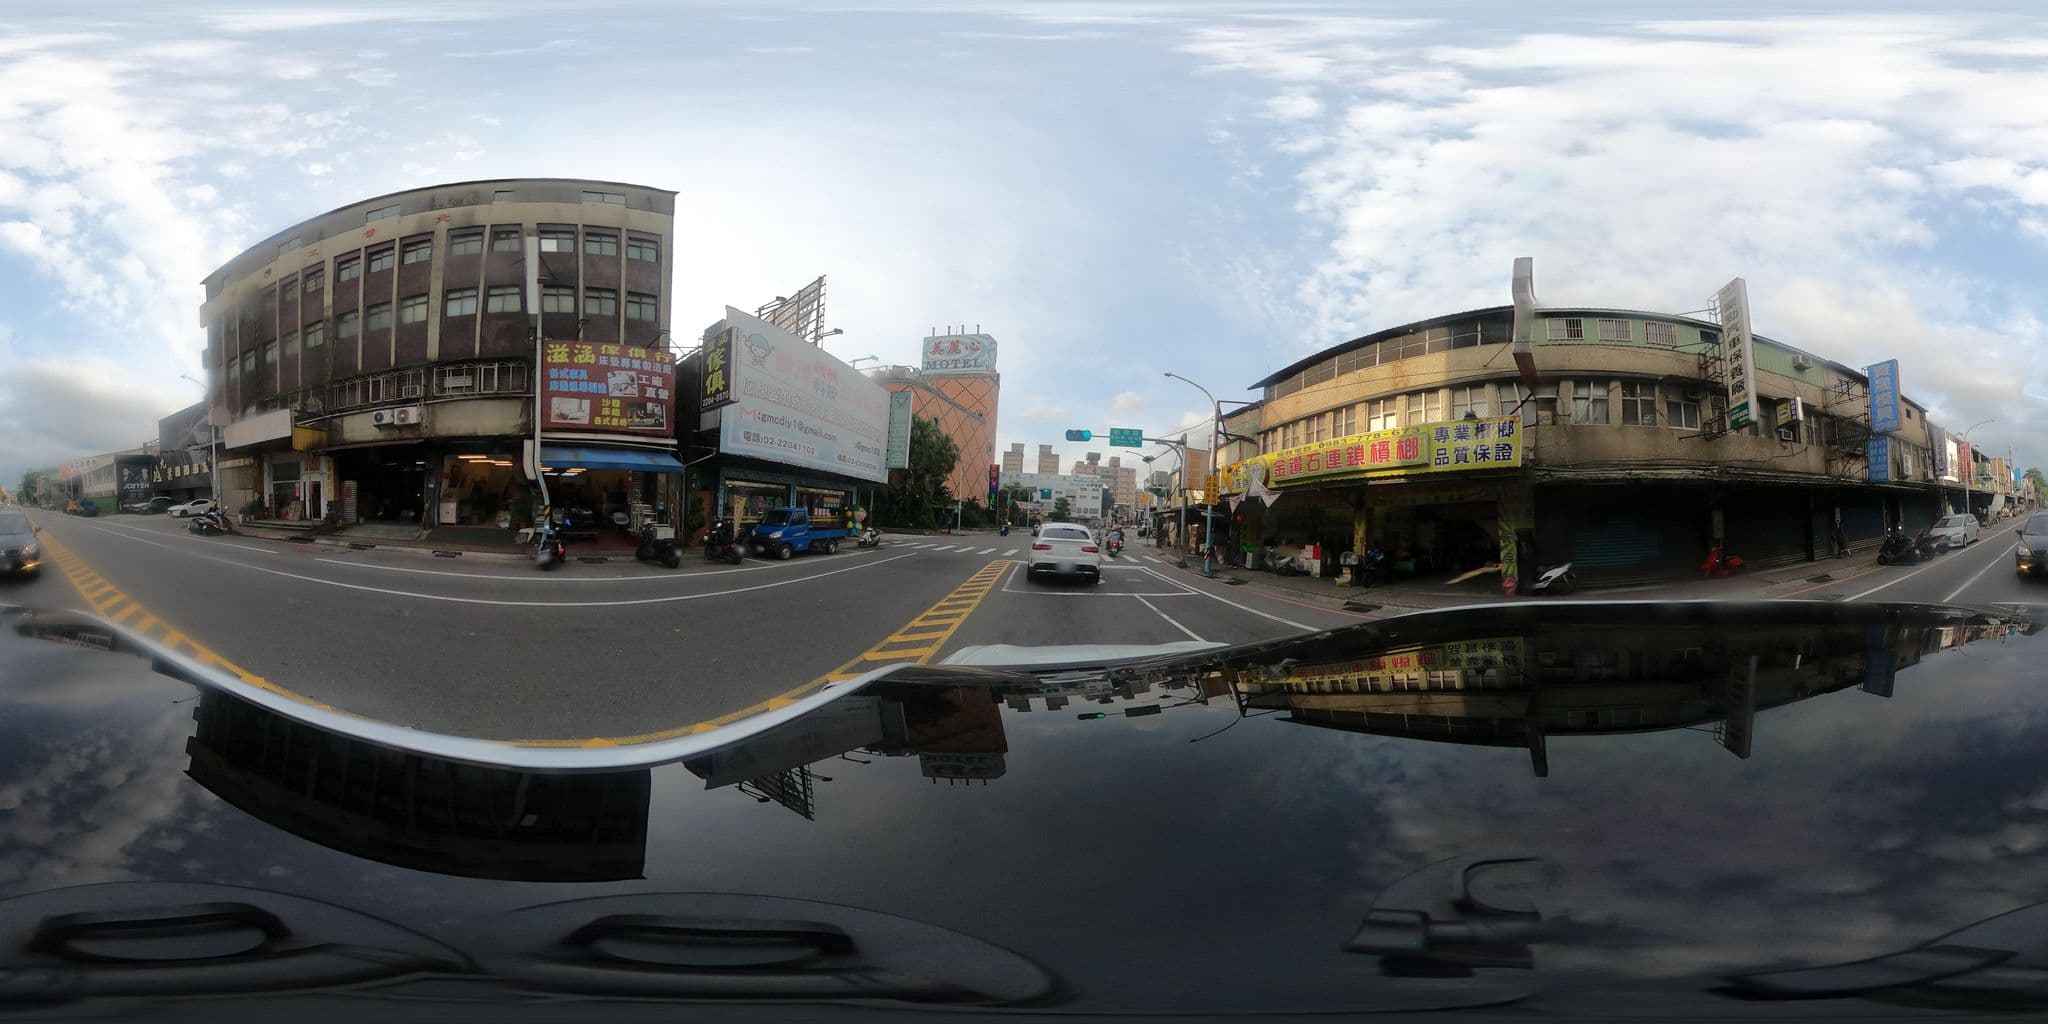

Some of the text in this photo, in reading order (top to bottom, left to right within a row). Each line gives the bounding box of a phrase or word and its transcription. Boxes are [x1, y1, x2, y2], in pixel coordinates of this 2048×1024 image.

[926, 358, 982, 370] MOTEL
[1273, 436, 1420, 478] 金鑽石連鎖檳榔
[1434, 442, 1514, 465] 品質保證
